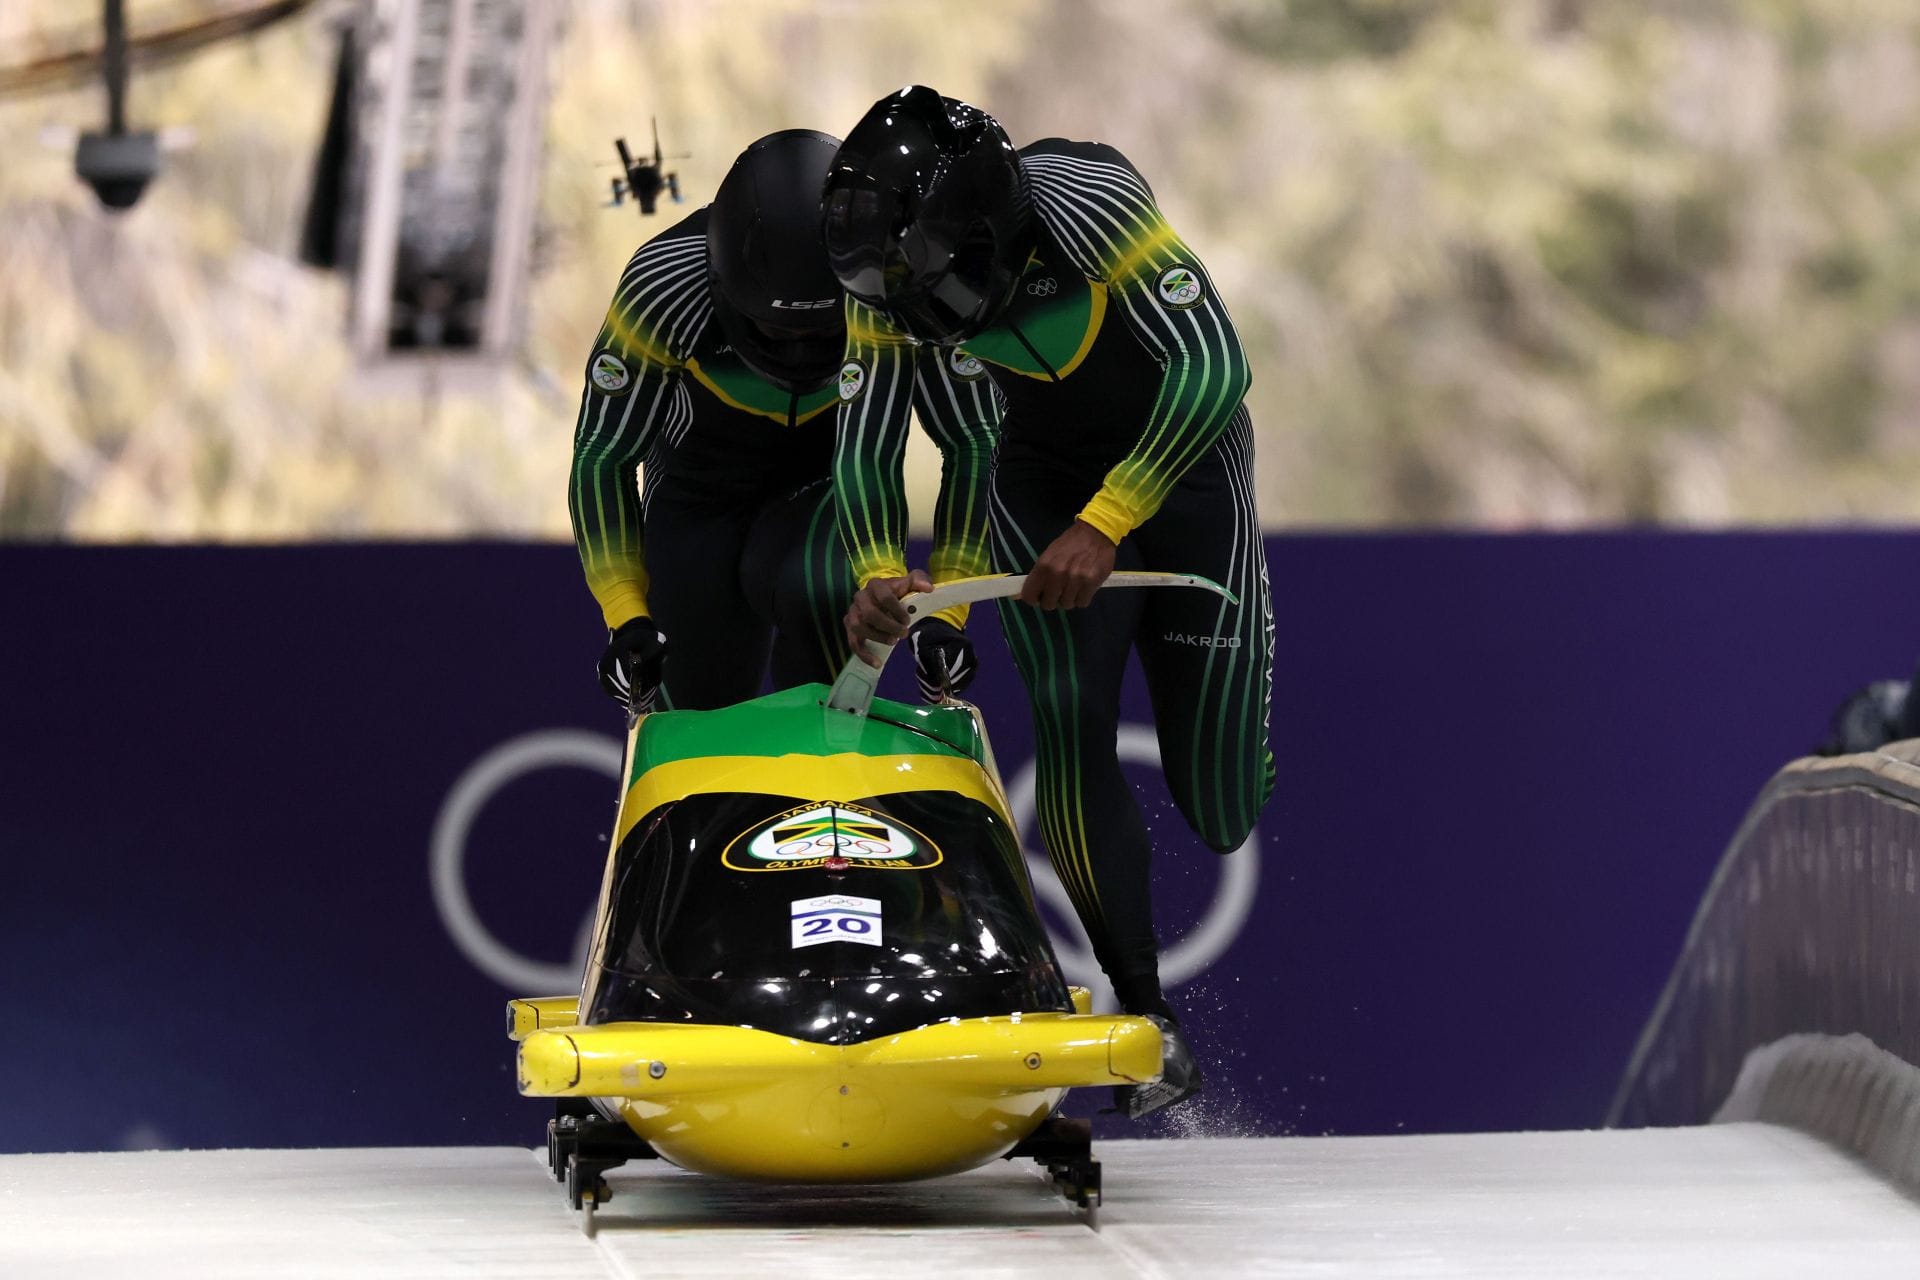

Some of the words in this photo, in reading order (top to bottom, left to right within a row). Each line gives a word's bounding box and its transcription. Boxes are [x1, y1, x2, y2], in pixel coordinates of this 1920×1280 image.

[771, 298, 836, 310] LS2
[1164, 631, 1242, 648] JAKROO
[782, 800, 872, 820] JAMAICA
[765, 857, 854, 869] OLYMPC
[861, 859, 913, 868] TEAM
[802, 918, 872, 937] 20
